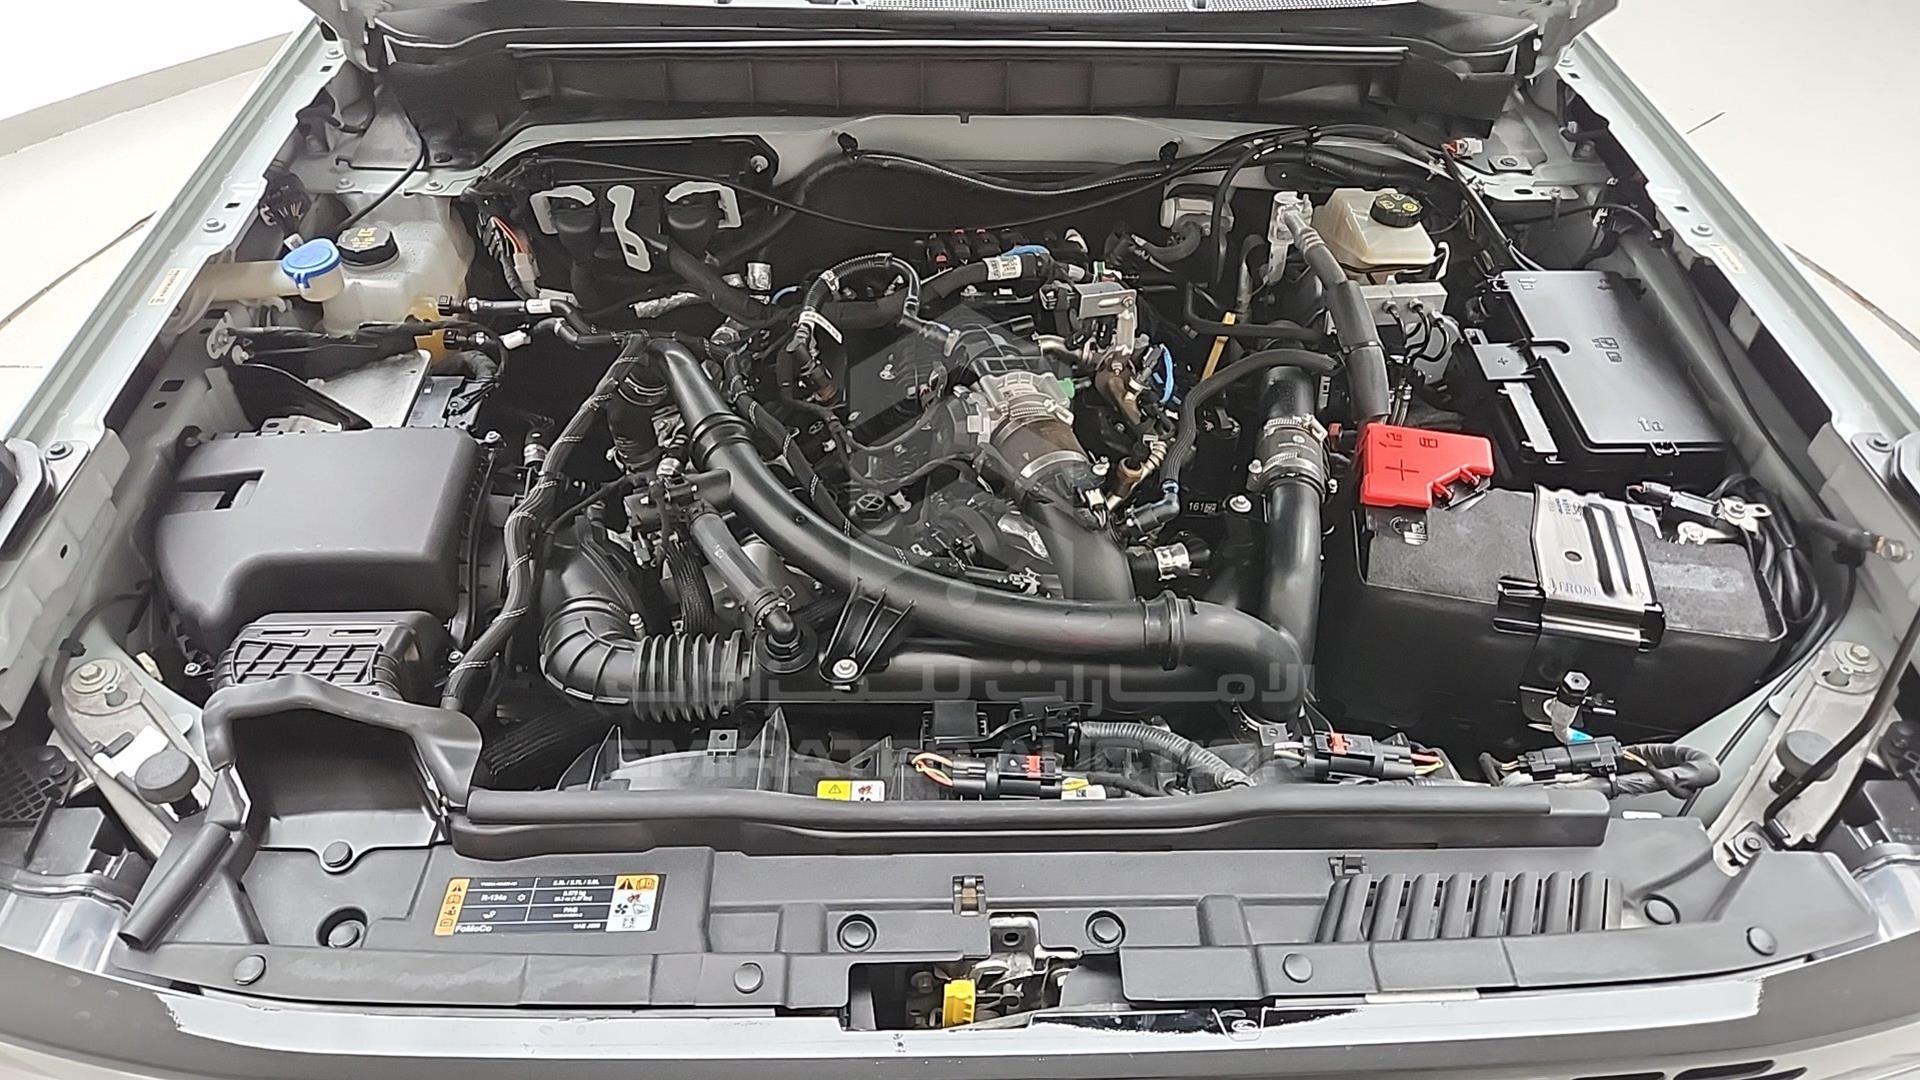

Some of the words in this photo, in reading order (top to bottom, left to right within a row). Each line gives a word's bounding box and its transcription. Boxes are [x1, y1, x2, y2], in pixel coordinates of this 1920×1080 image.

[1558, 581, 1598, 597] FRONT
[480, 893, 508, 902] R-134a
[455, 925, 493, 933] FoMoCo
